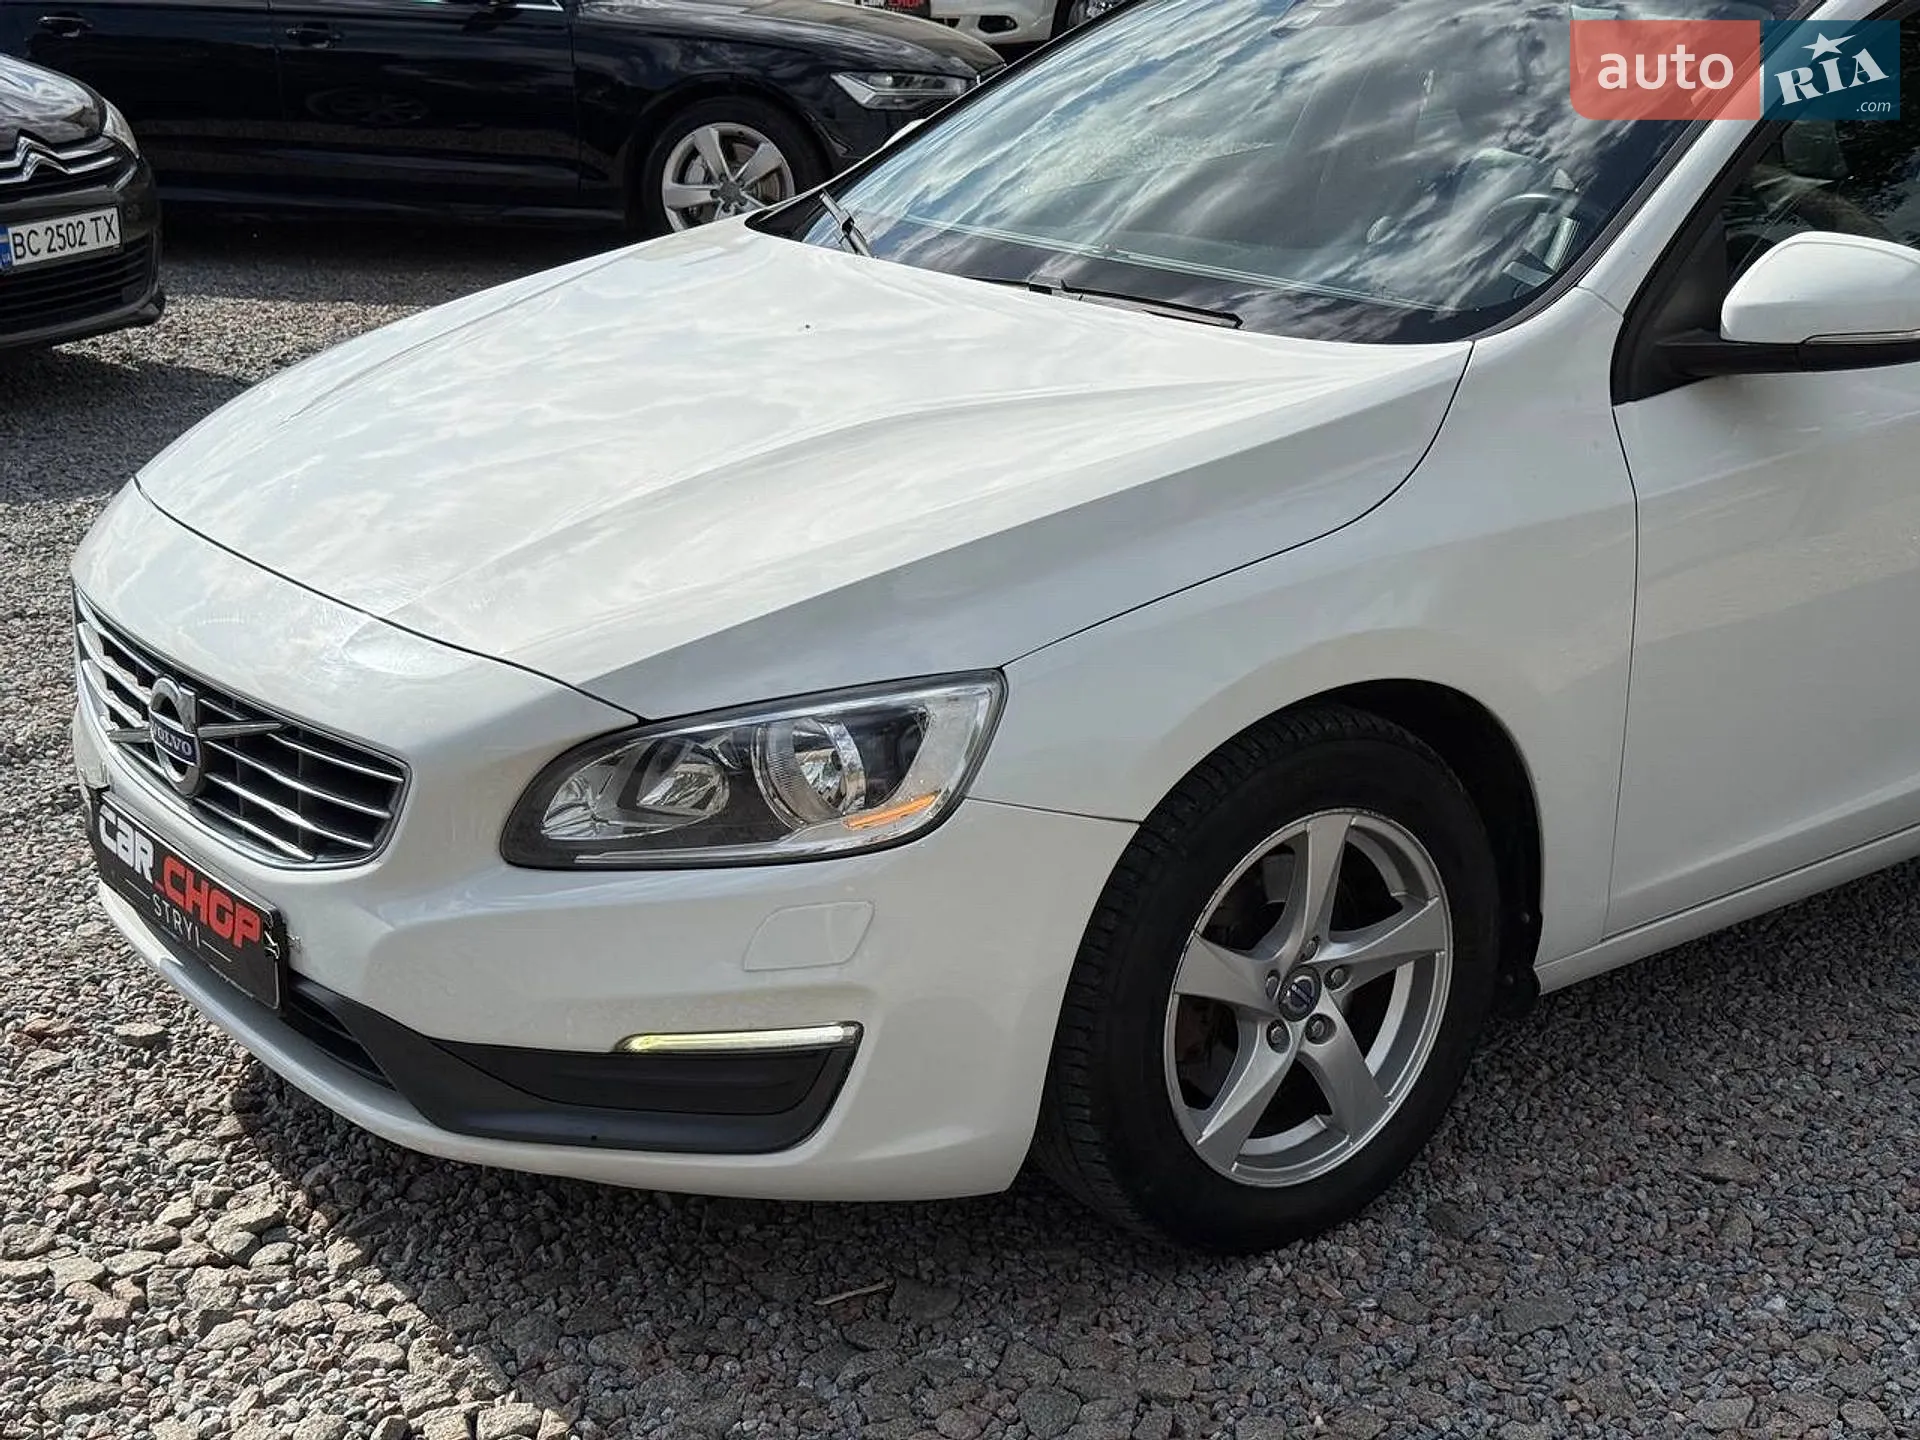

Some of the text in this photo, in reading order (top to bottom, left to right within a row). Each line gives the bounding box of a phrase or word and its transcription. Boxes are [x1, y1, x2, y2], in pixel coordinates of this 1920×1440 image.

[12, 214, 117, 260] BC 2502 TX
[152, 893, 201, 950] STRYI
